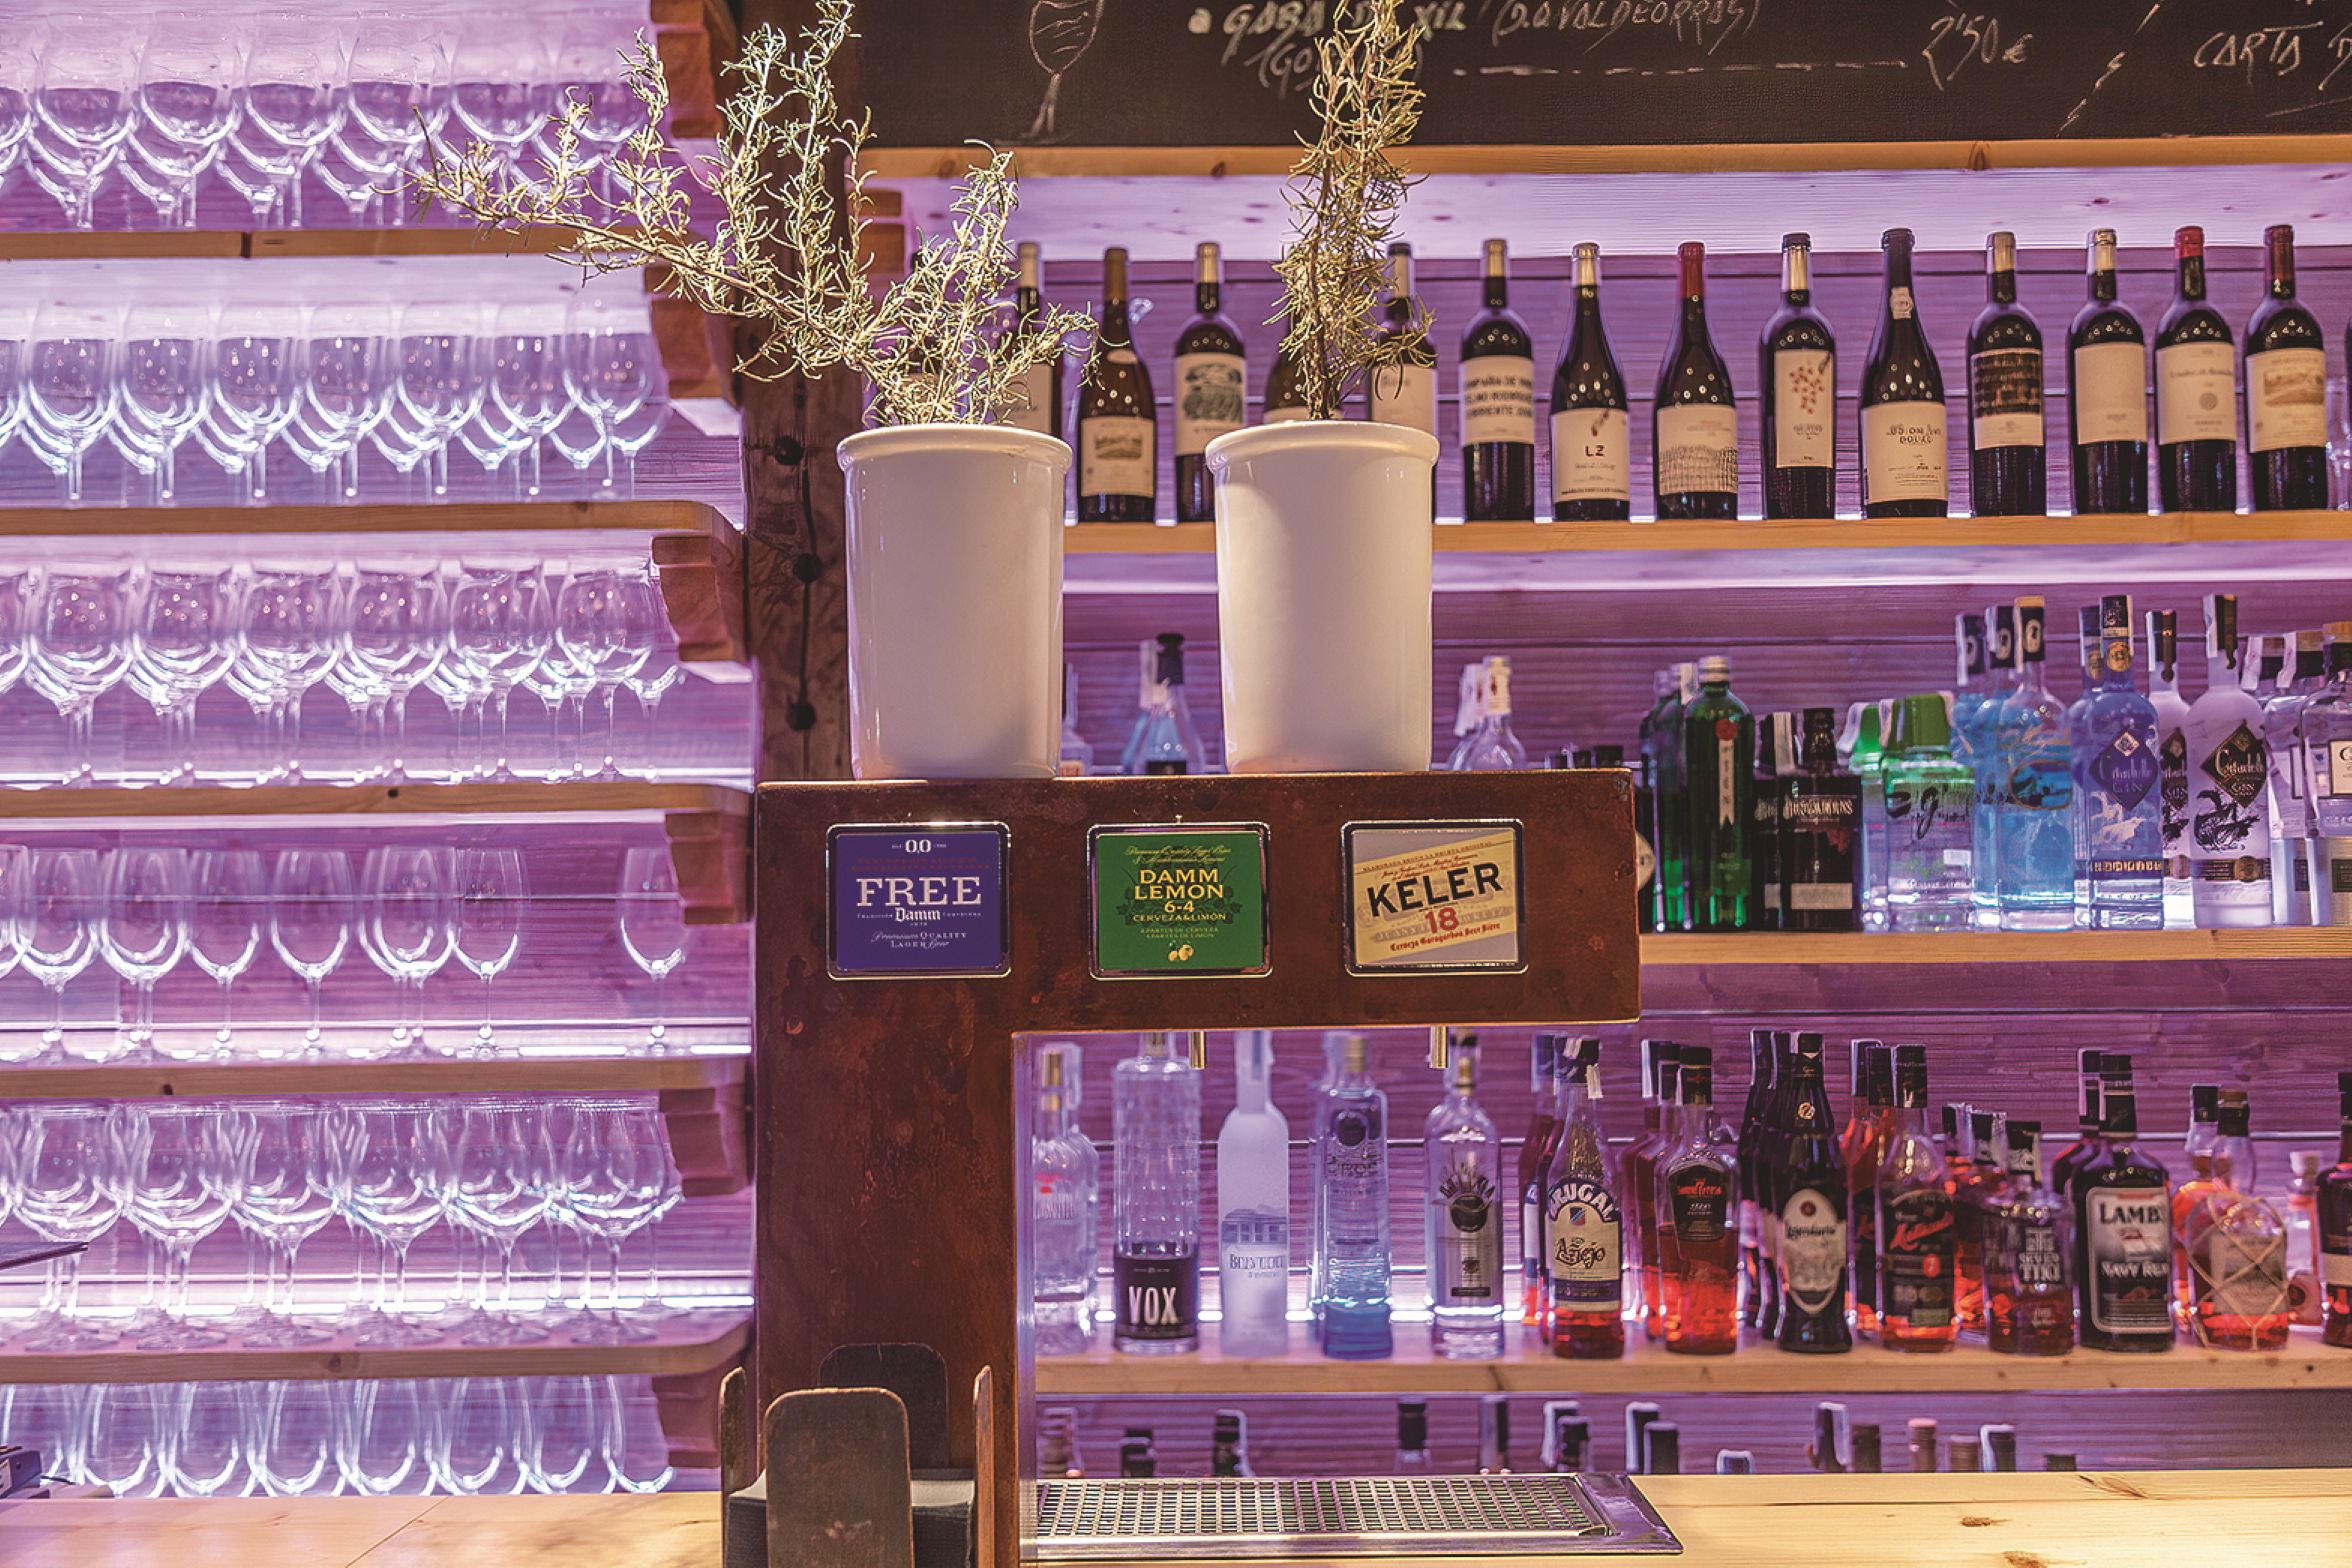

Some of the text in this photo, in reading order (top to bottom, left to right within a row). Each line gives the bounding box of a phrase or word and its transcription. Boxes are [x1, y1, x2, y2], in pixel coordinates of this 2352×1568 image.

[2193, 20, 2324, 84] CARTA
[1140, 868, 1219, 884] DAMM
[856, 876, 982, 907] FREE
[1134, 884, 1224, 900] LEMON
[1366, 861, 1504, 919] KELER
[894, 906, 941, 922] Damm
[1163, 900, 1195, 913] 6-4
[1424, 906, 1460, 934] 18
[920, 930, 968, 940] QUALITY
[1128, 1286, 1179, 1325] VOX
